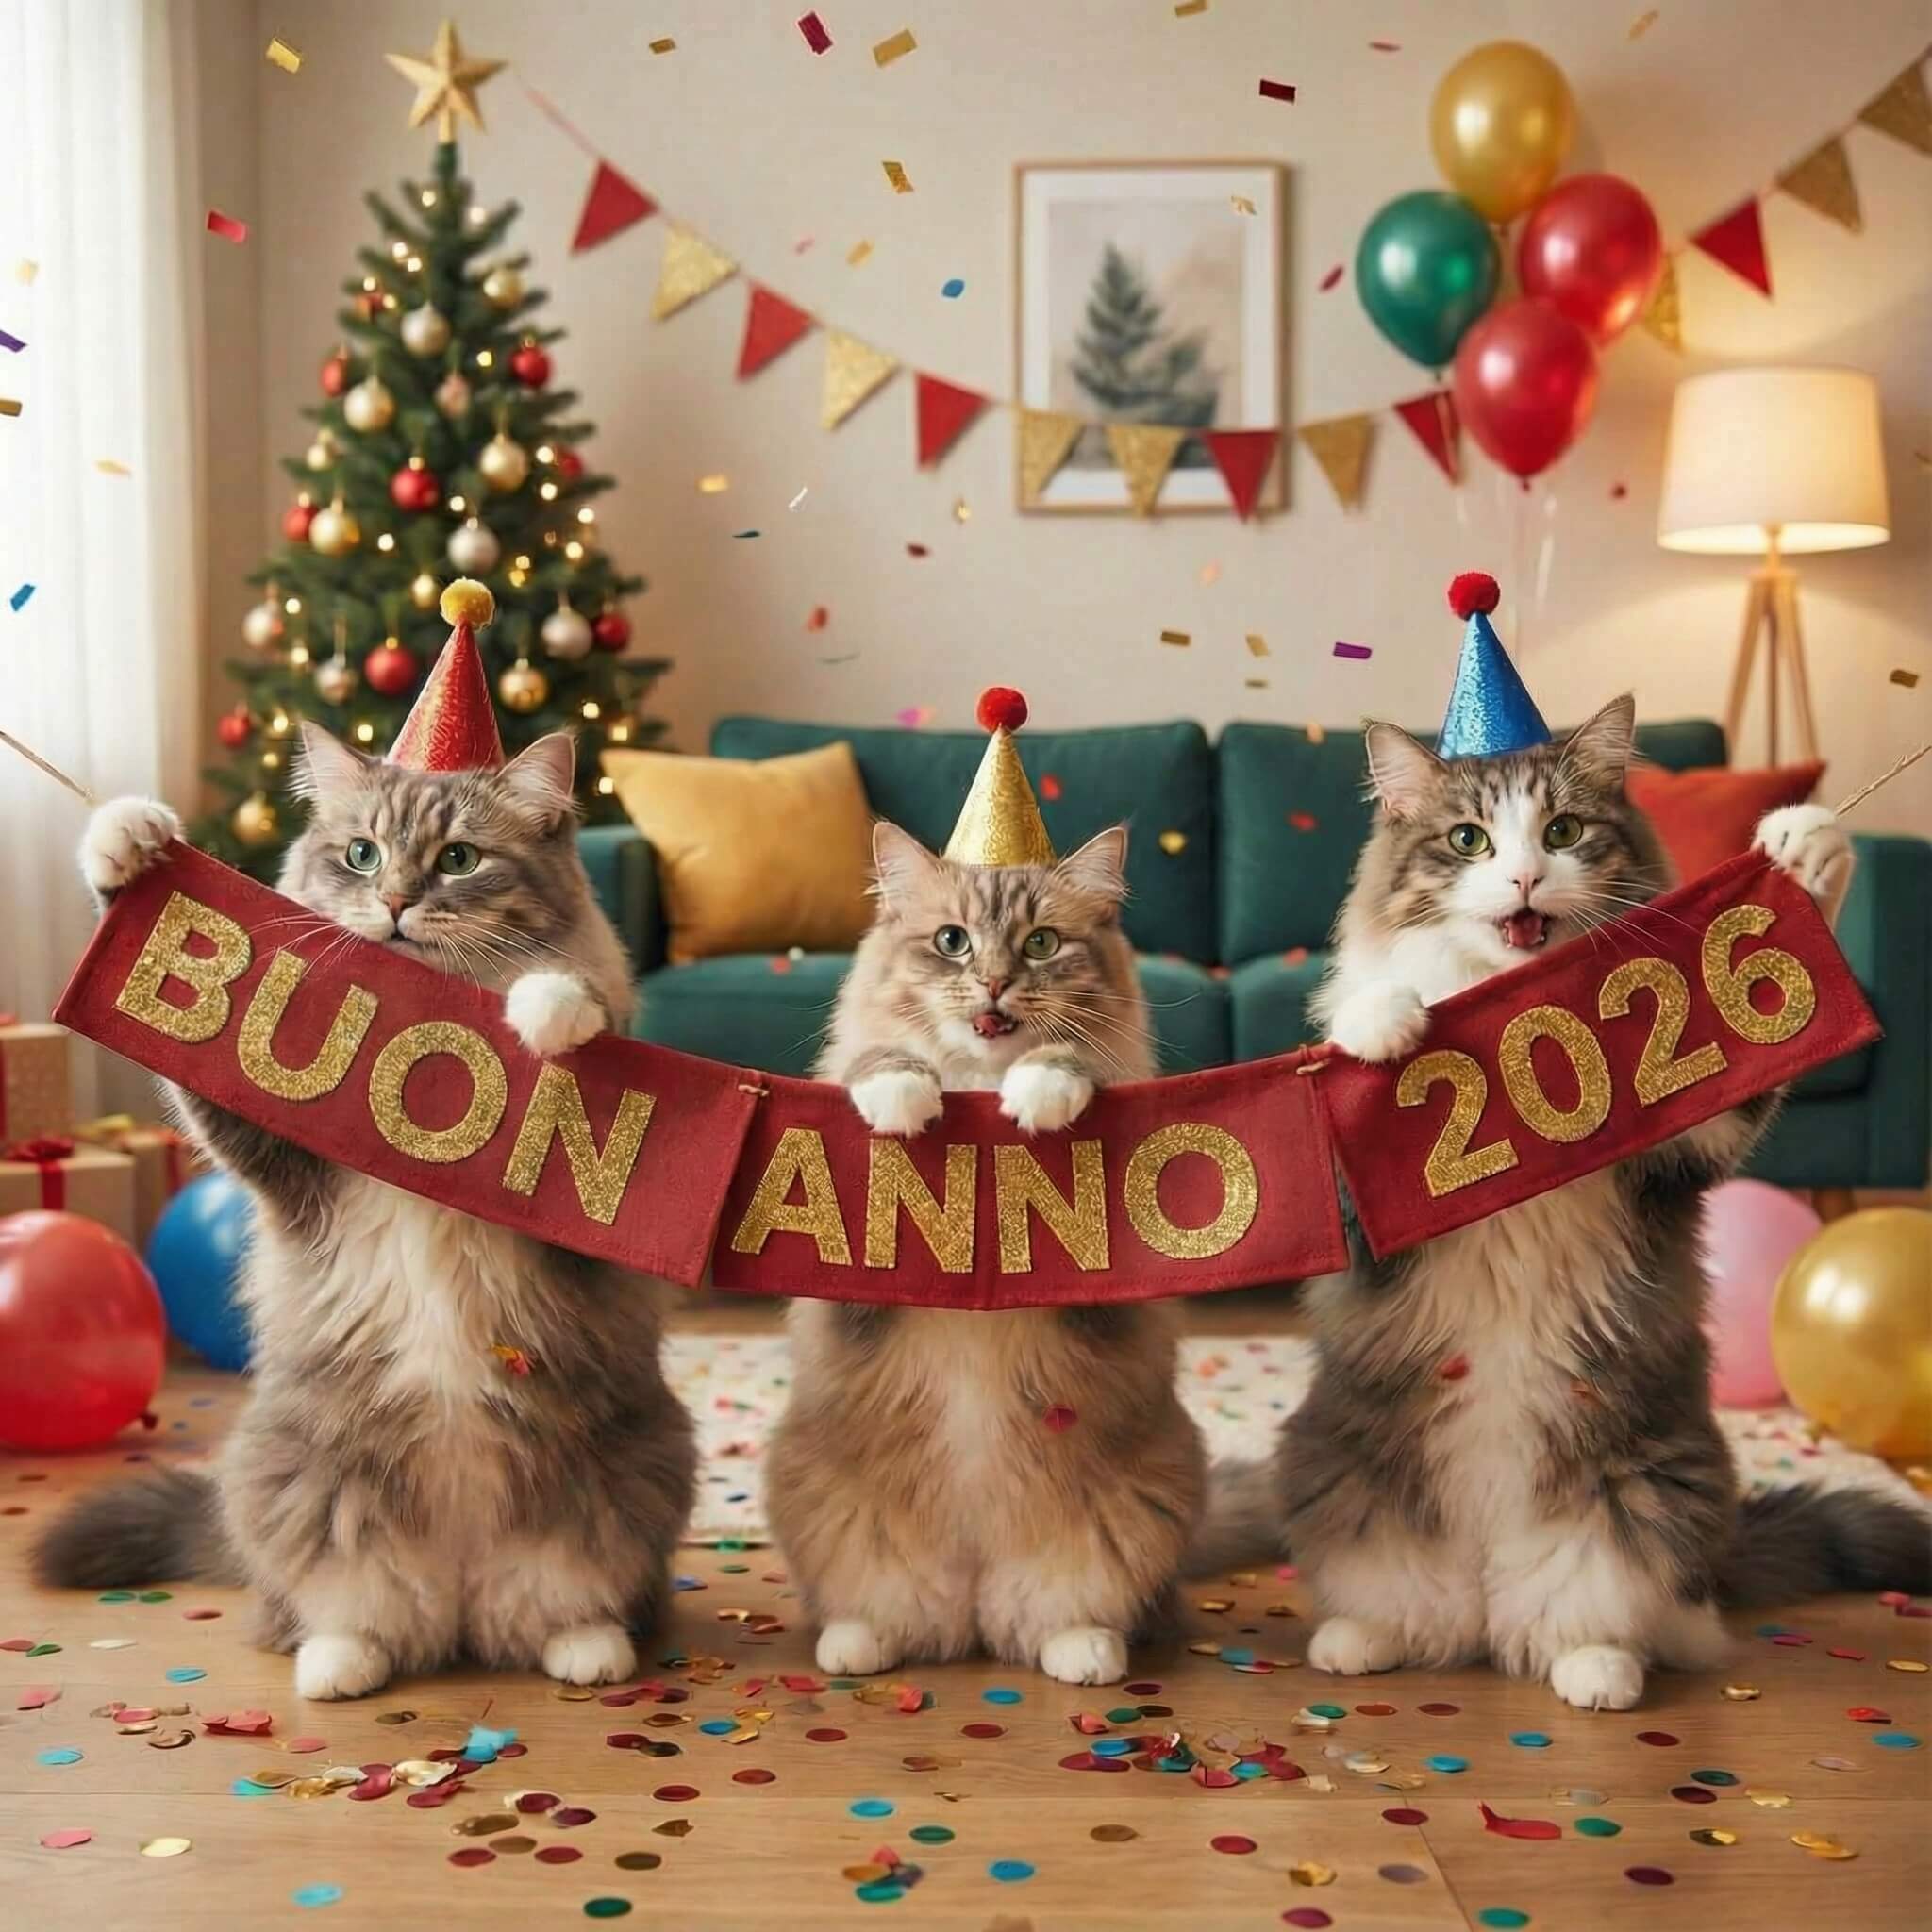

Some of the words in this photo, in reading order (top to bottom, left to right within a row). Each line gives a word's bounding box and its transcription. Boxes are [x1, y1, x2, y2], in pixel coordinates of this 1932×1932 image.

[114, 891, 656, 1225] BUON
[731, 1123, 1258, 1274] ANNO
[1396, 904, 1817, 1198] 2026
